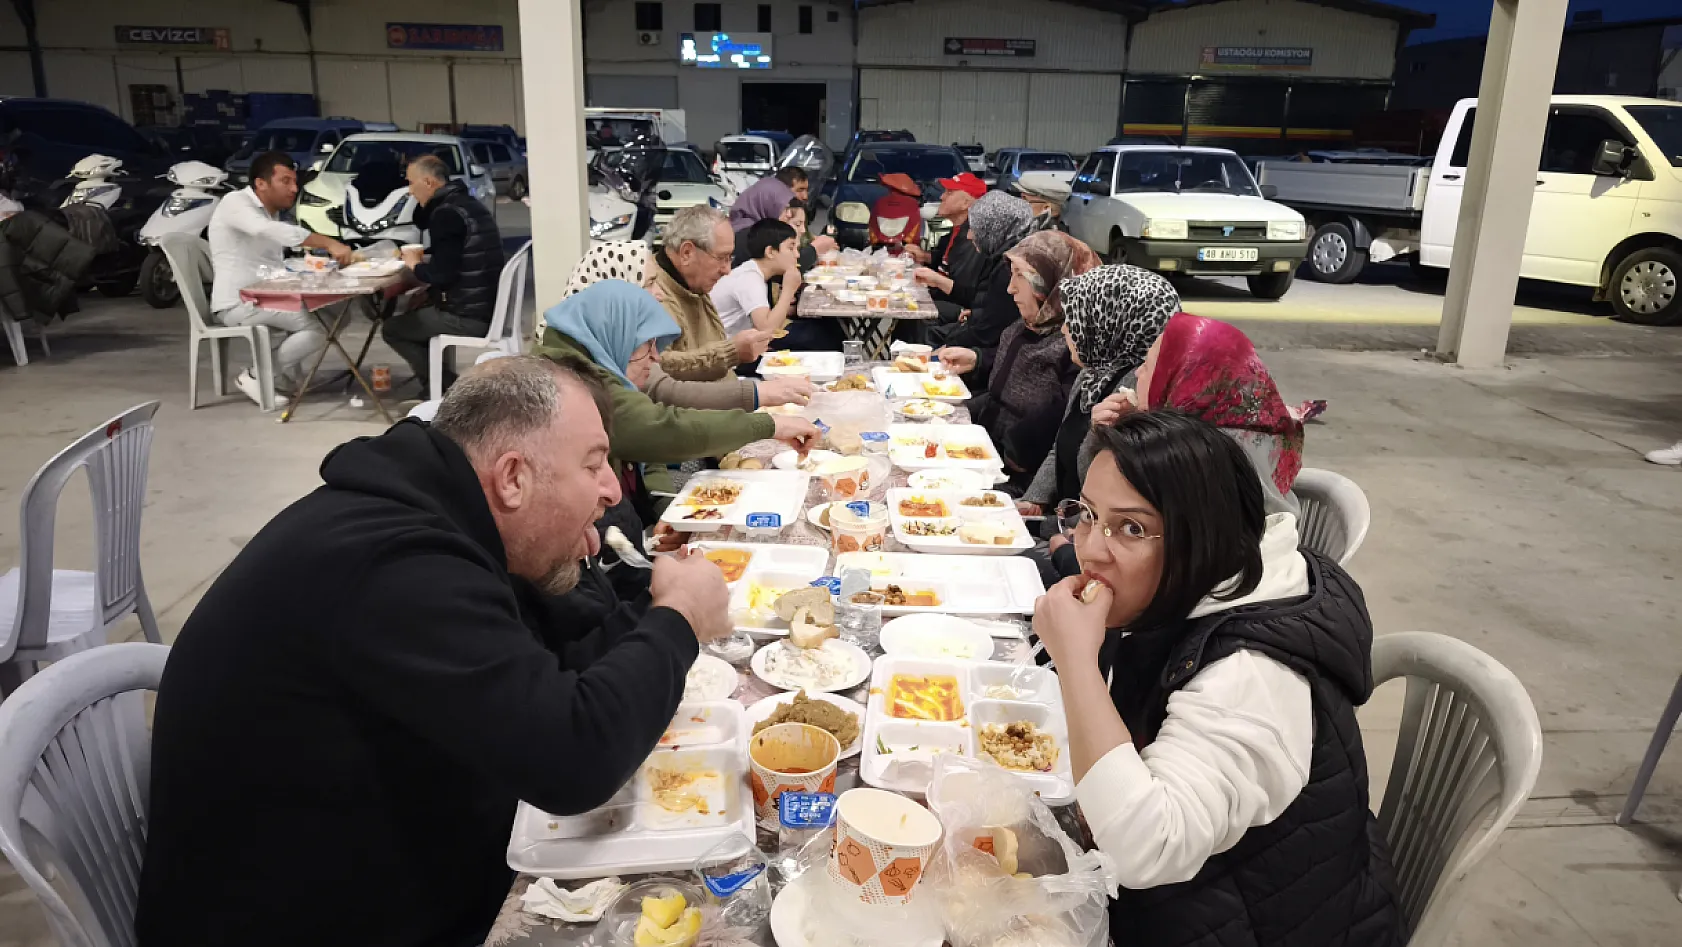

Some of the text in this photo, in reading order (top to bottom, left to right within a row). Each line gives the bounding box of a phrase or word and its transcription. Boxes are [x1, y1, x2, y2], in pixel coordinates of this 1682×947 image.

[1205, 249, 1256, 259] 48 AHU 510
